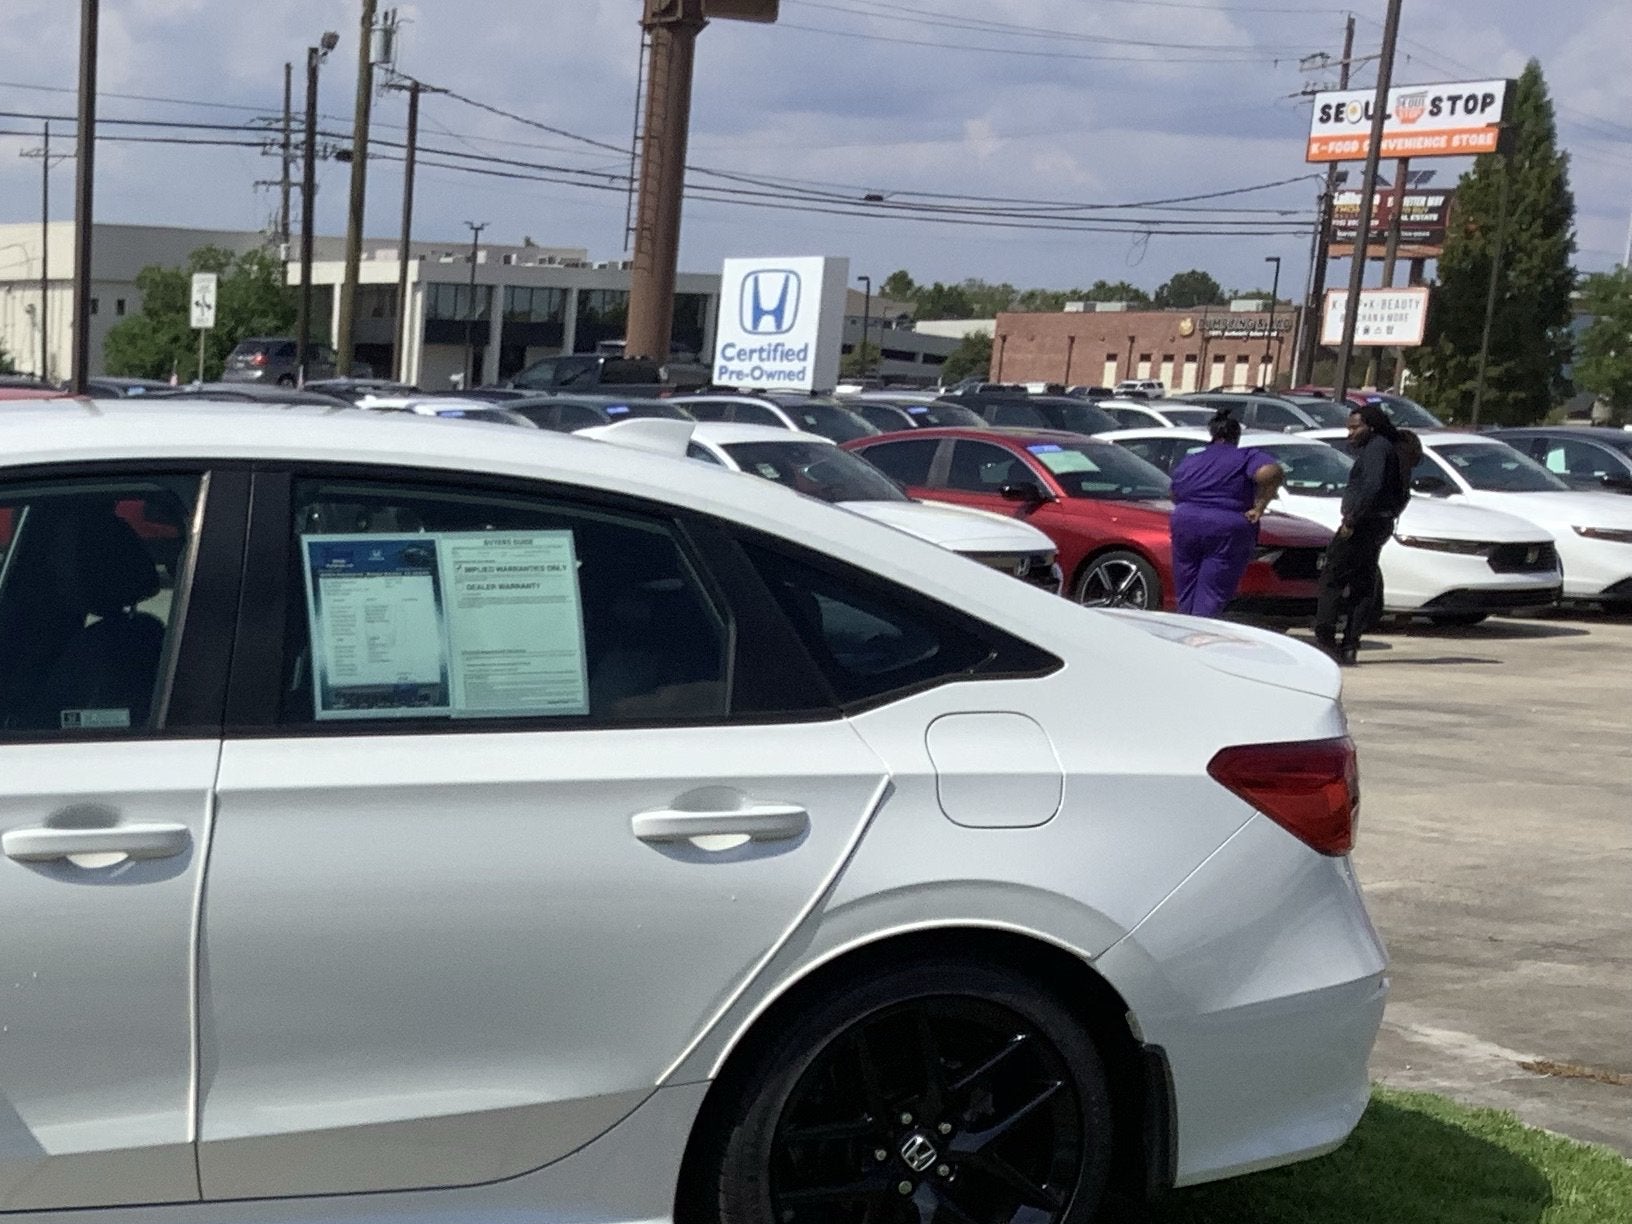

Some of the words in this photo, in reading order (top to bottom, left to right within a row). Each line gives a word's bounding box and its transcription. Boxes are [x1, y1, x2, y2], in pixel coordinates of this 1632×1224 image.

[1429, 93, 1495, 116] STOP
[1311, 140, 1360, 154] K-FOOD
[1363, 134, 1447, 152] CNVENIENCE
[1452, 132, 1495, 147] STORE
[721, 342, 809, 362] Certified
[718, 365, 806, 381] Pre-Owned
[547, 564, 567, 572] ONLY
